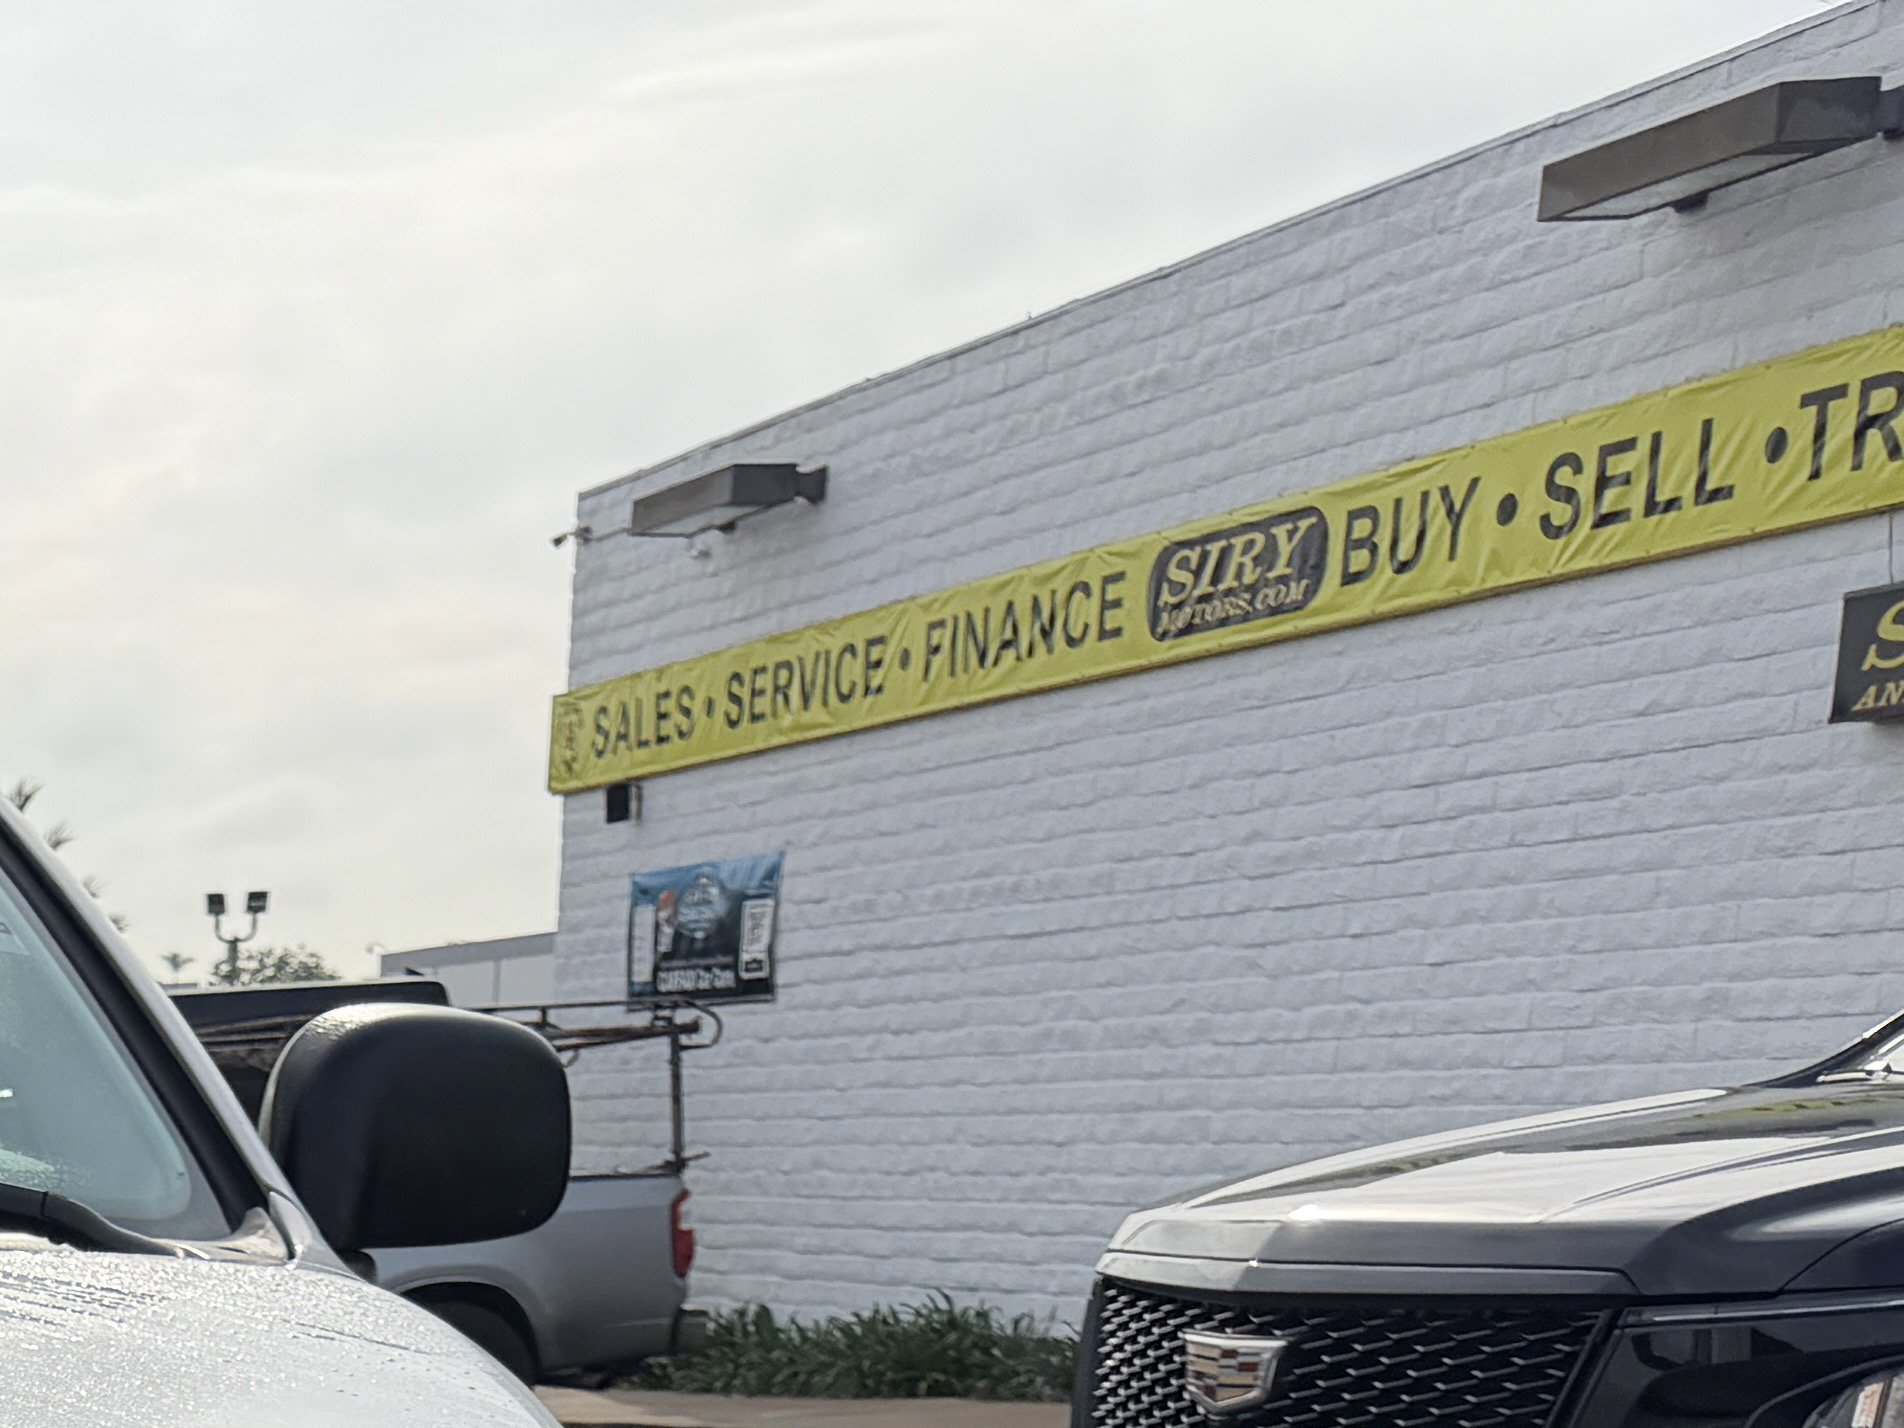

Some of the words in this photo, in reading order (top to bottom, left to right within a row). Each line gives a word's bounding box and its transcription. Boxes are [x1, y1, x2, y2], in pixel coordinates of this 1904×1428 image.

[593, 683, 694, 759] SALES
[724, 634, 889, 731] SERVICE
[923, 570, 1127, 684] FINANCE
[1340, 475, 1482, 588] BUY
[1538, 417, 1735, 541] SELL
[1157, 516, 1319, 608] SIRY
